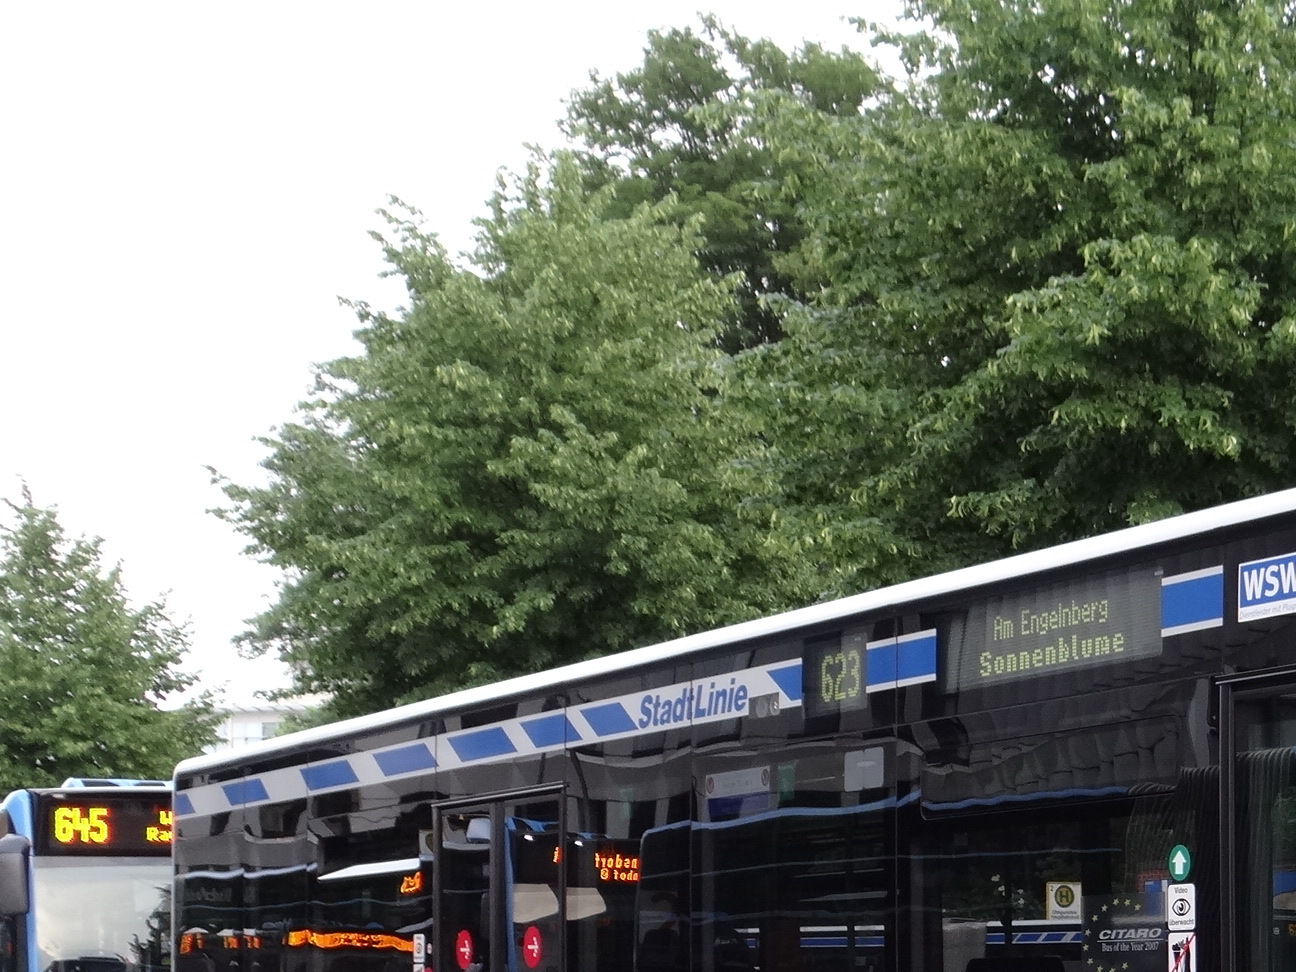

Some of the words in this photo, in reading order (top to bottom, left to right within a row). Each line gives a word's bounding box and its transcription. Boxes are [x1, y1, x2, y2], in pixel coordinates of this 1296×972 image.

[994, 616, 1014, 641] Am
[980, 632, 1124, 677] Sonnenblume
[822, 650, 859, 702] 623
[638, 678, 748, 729] StadtLinie
[54, 807, 108, 843] 645
[1099, 928, 1163, 940] CITARO
[1102, 944, 1113, 952] Bus
[1120, 943, 1130, 951] the
